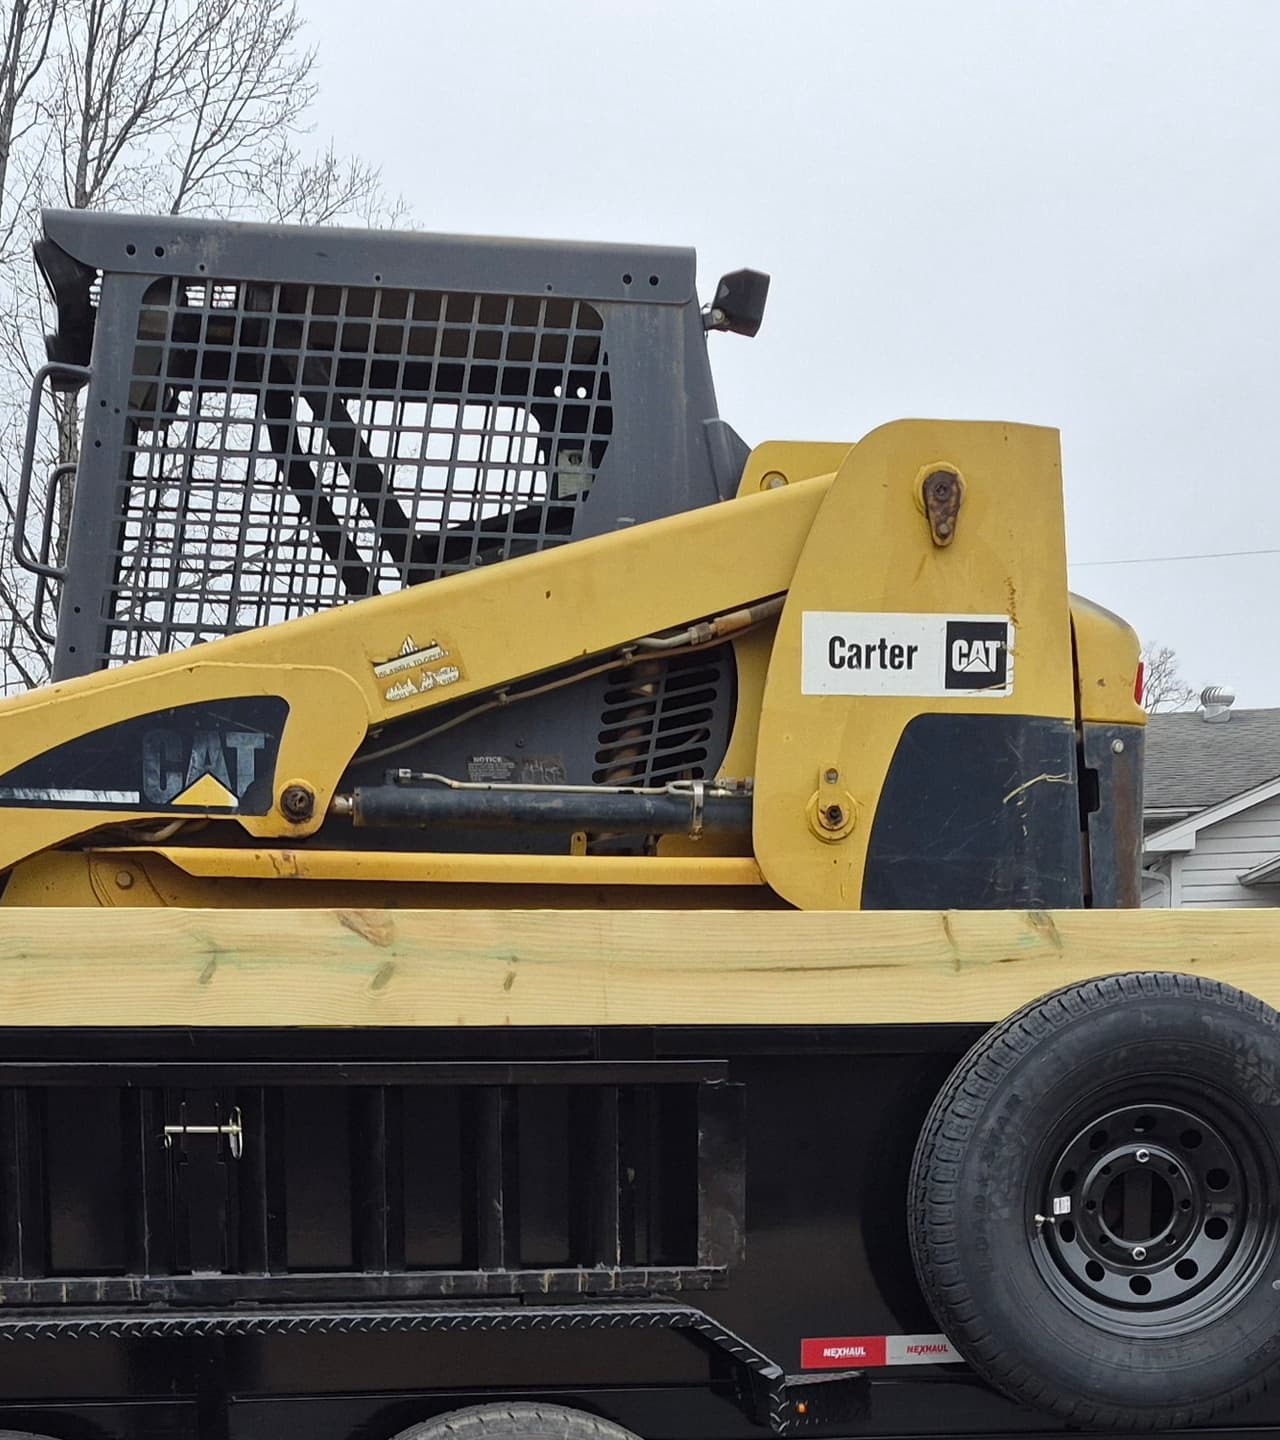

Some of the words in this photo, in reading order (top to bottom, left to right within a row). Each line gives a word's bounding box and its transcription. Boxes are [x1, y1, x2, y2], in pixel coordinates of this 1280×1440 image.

[828, 635, 918, 671] Carter
[951, 639, 1000, 673] CAT
[143, 730, 265, 804] CAT
[823, 1346, 866, 1359] NEXHAUL
[906, 1344, 949, 1356] NEXHAUL
